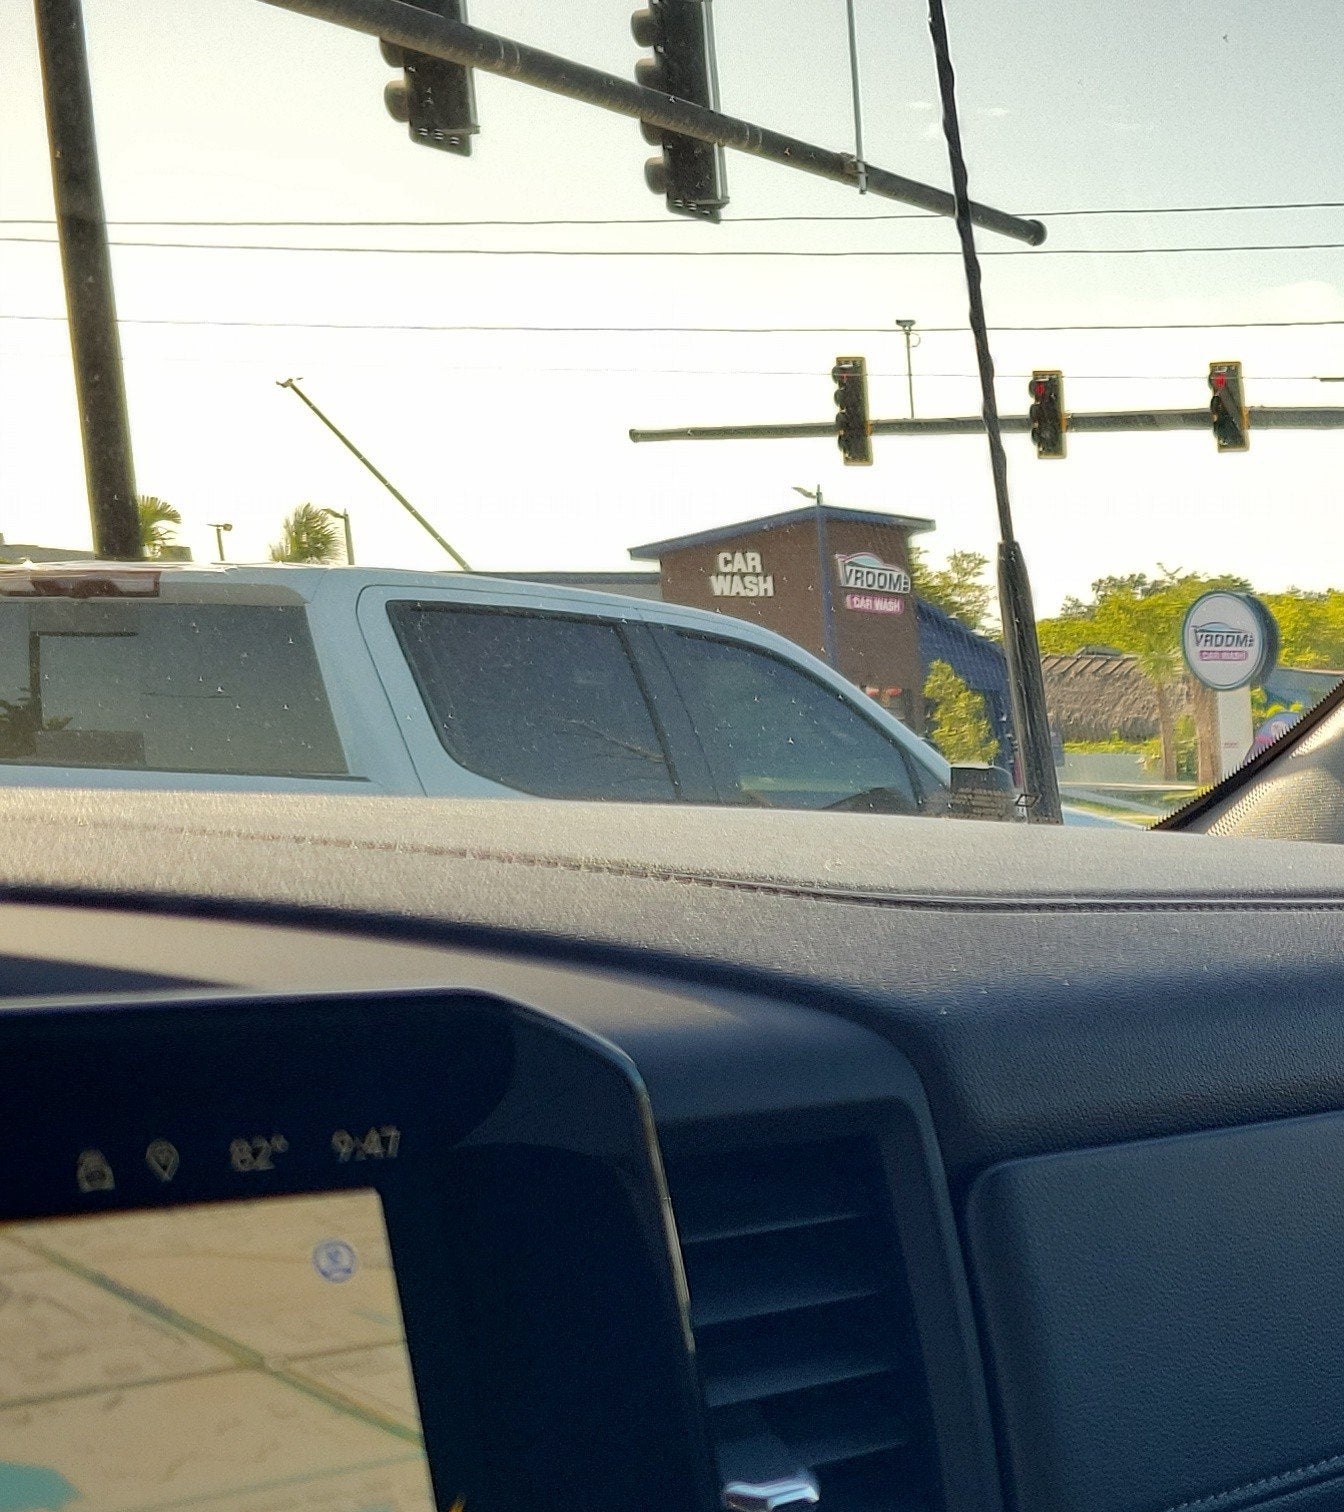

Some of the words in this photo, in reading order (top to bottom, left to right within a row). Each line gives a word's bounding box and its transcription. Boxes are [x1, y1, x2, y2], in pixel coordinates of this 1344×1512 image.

[717, 551, 763, 573] CAR
[709, 575, 774, 597] WASH
[874, 598, 901, 612] WASH
[331, 1125, 401, 1163] 9:47
